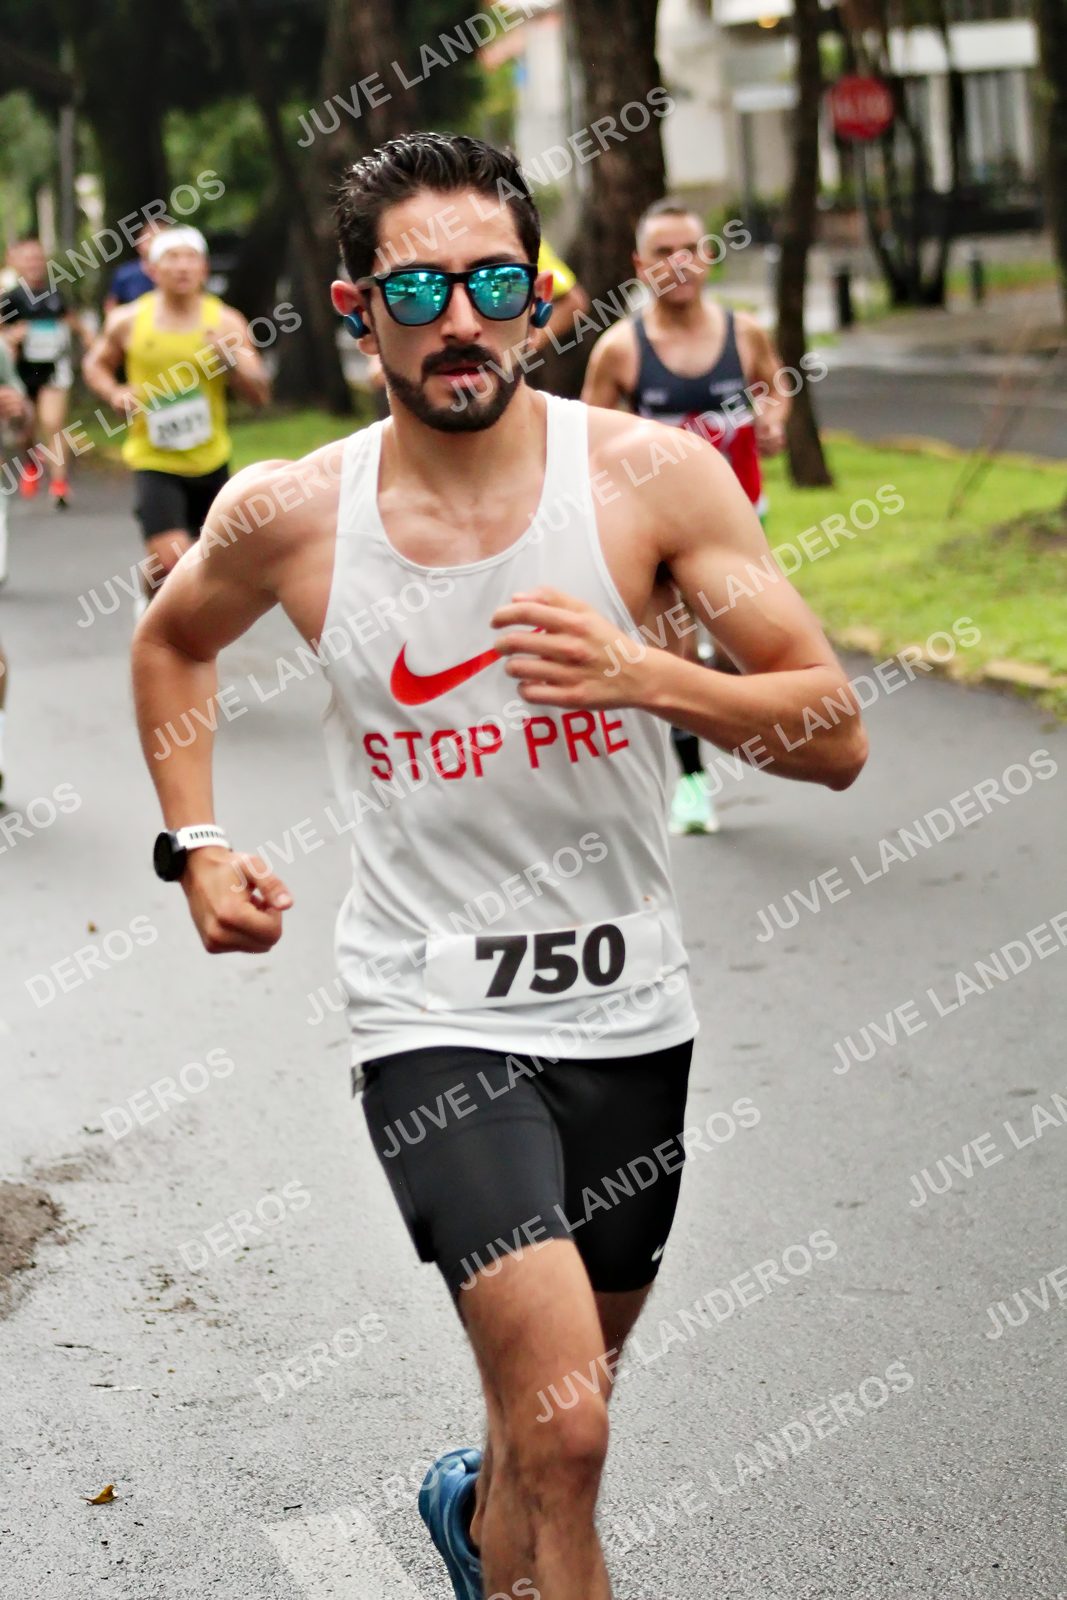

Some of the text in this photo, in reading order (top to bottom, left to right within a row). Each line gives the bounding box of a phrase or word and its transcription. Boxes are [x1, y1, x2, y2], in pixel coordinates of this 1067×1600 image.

[363, 709, 629, 780] STOP PRE
[475, 923, 626, 998] 750
